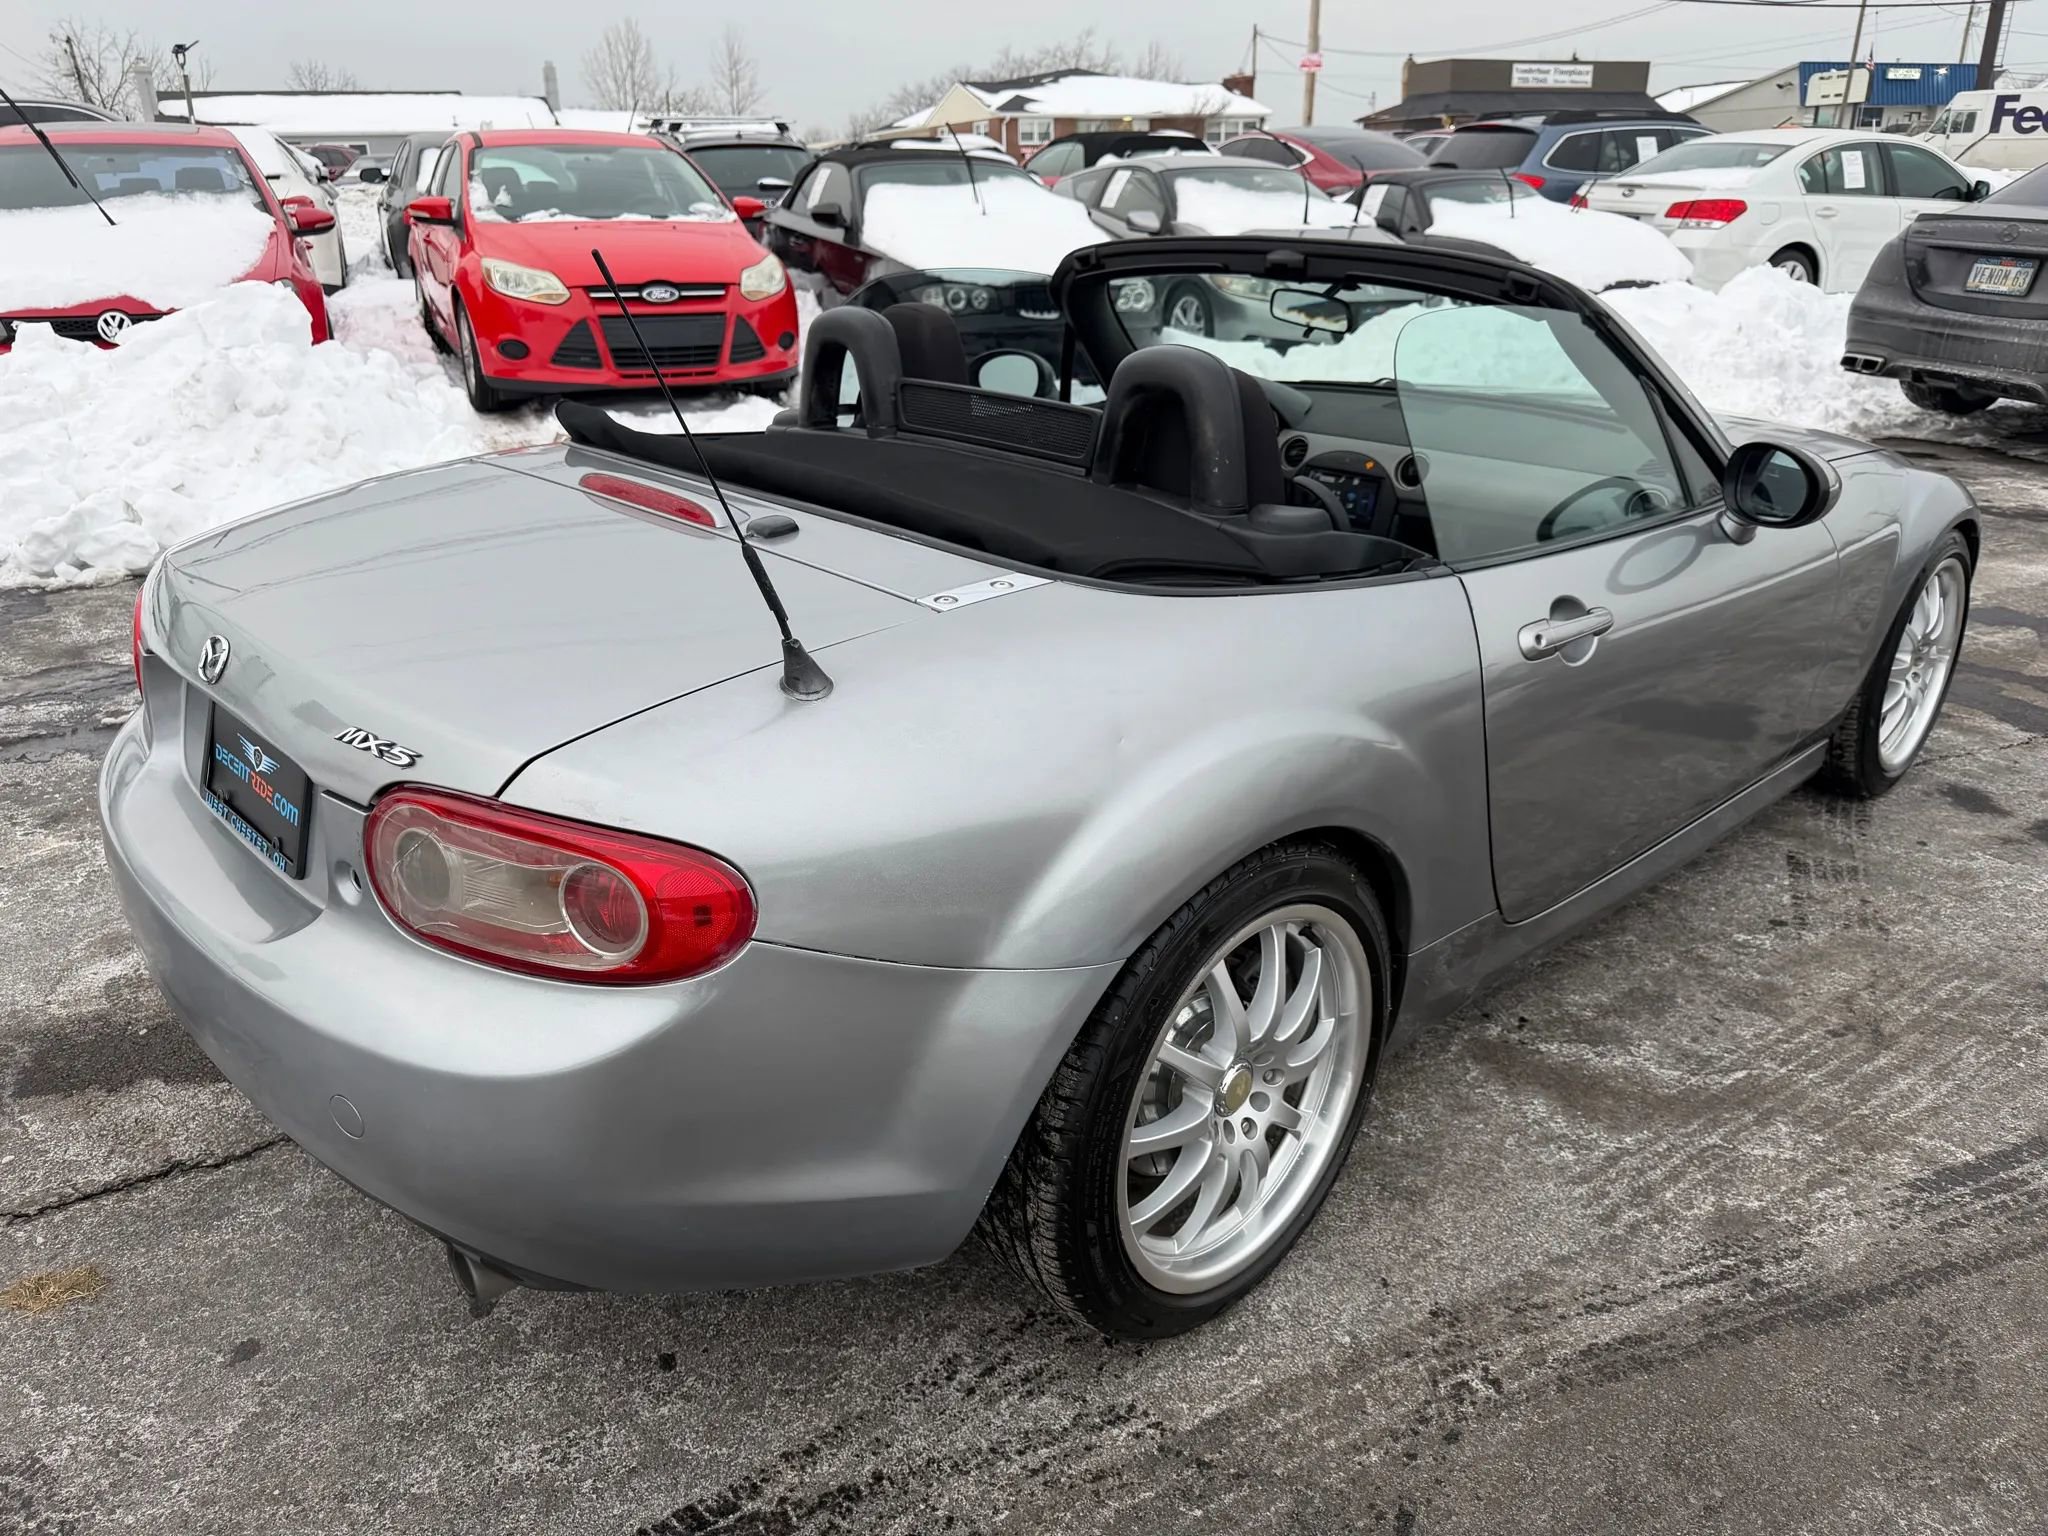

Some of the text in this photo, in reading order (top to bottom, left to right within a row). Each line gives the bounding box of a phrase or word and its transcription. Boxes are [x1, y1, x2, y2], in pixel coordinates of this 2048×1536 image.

[1989, 94, 2048, 134] Fe
[1972, 266, 2011, 287] VENOM
[334, 726, 422, 769] MX-5
[205, 792, 228, 821] WEST
[273, 852, 287, 873] OH
